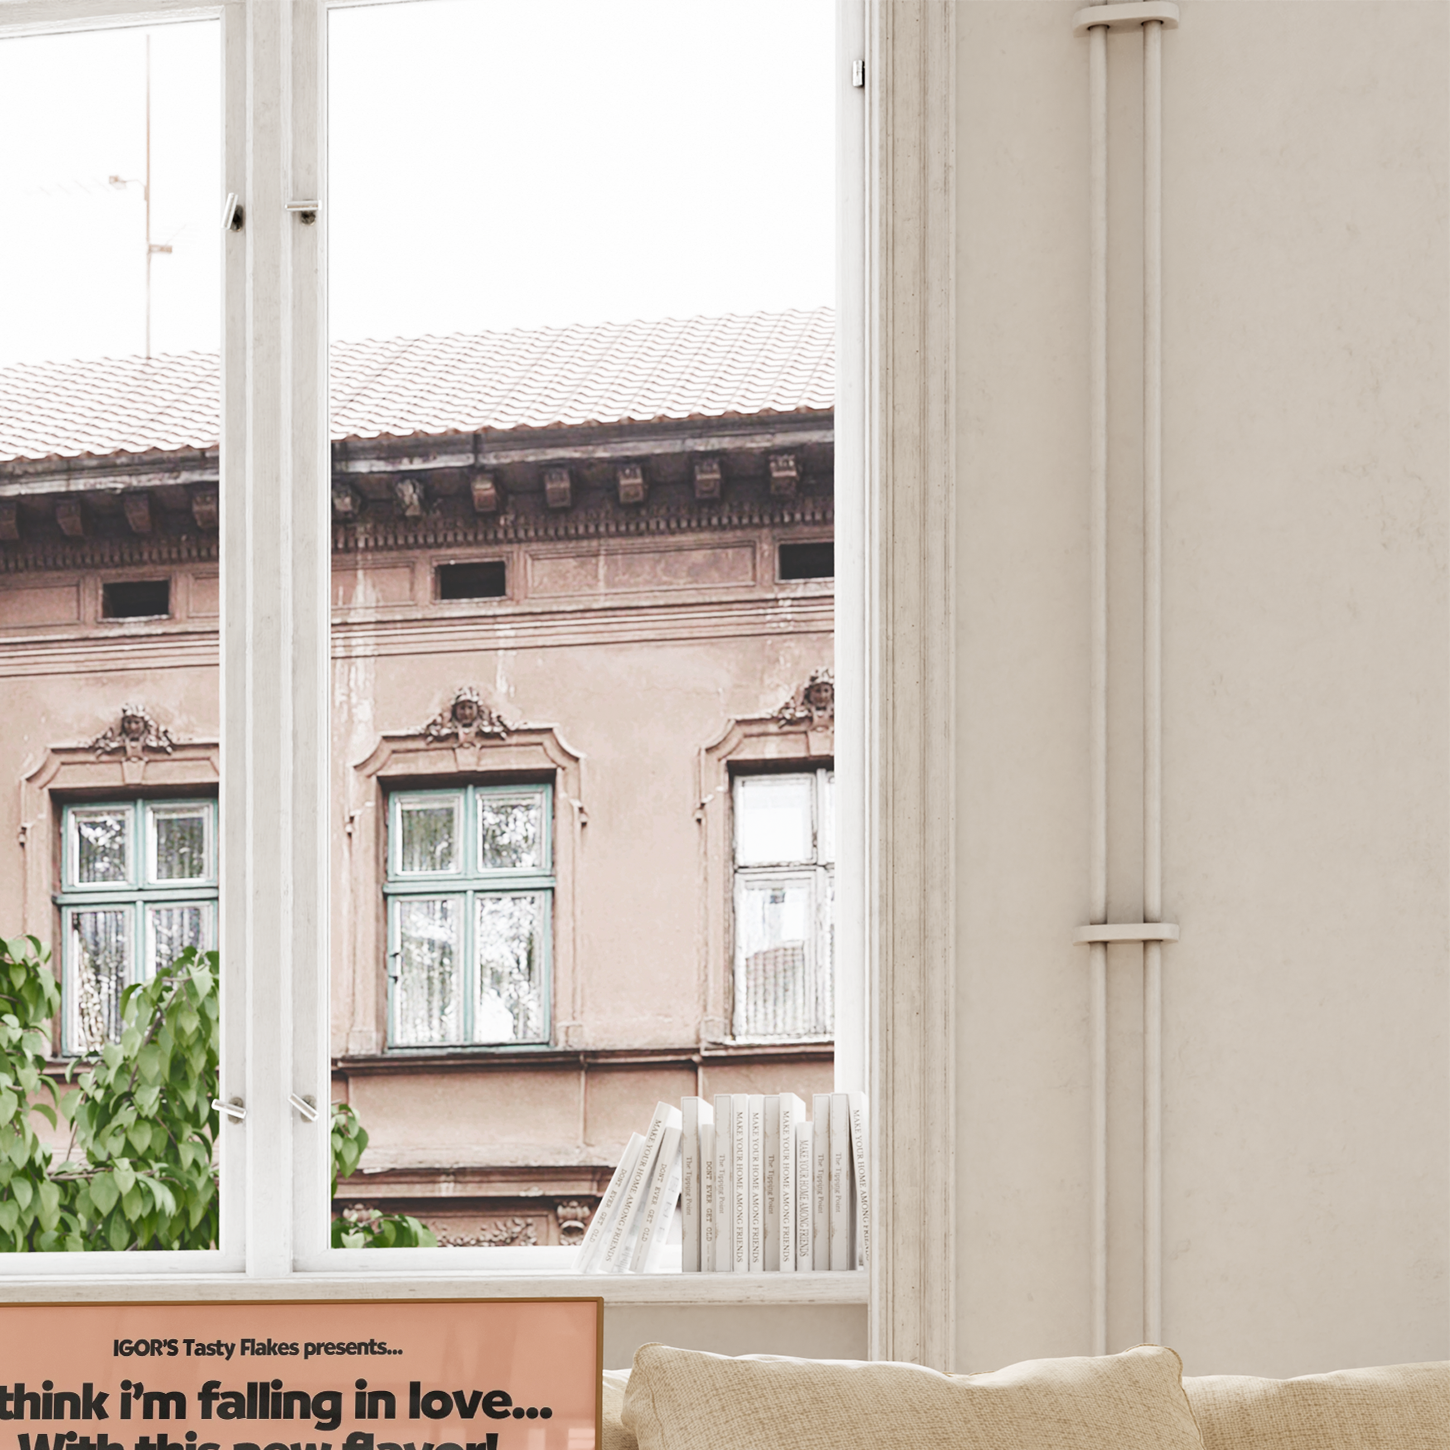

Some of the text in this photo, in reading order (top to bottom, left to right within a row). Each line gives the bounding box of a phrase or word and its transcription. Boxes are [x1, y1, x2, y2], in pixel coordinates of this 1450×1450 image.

[605, 1119, 662, 1262] MAKE YOUR HOME AMONG FRIENDS
[767, 1169, 775, 1196] Tipping
[799, 1140, 809, 1257] MAKE YOUR HOME AMONG FRIENDS
[853, 1109, 869, 1223] MAKE YOUR HOME AMONG
[113, 1339, 403, 1360] IGOR'S Tasty Flakes presents...
[121, 1380, 185, 1420] i'm
[198, 1380, 342, 1431] falling
[355, 1380, 396, 1420] in
[409, 1382, 552, 1420] love...
